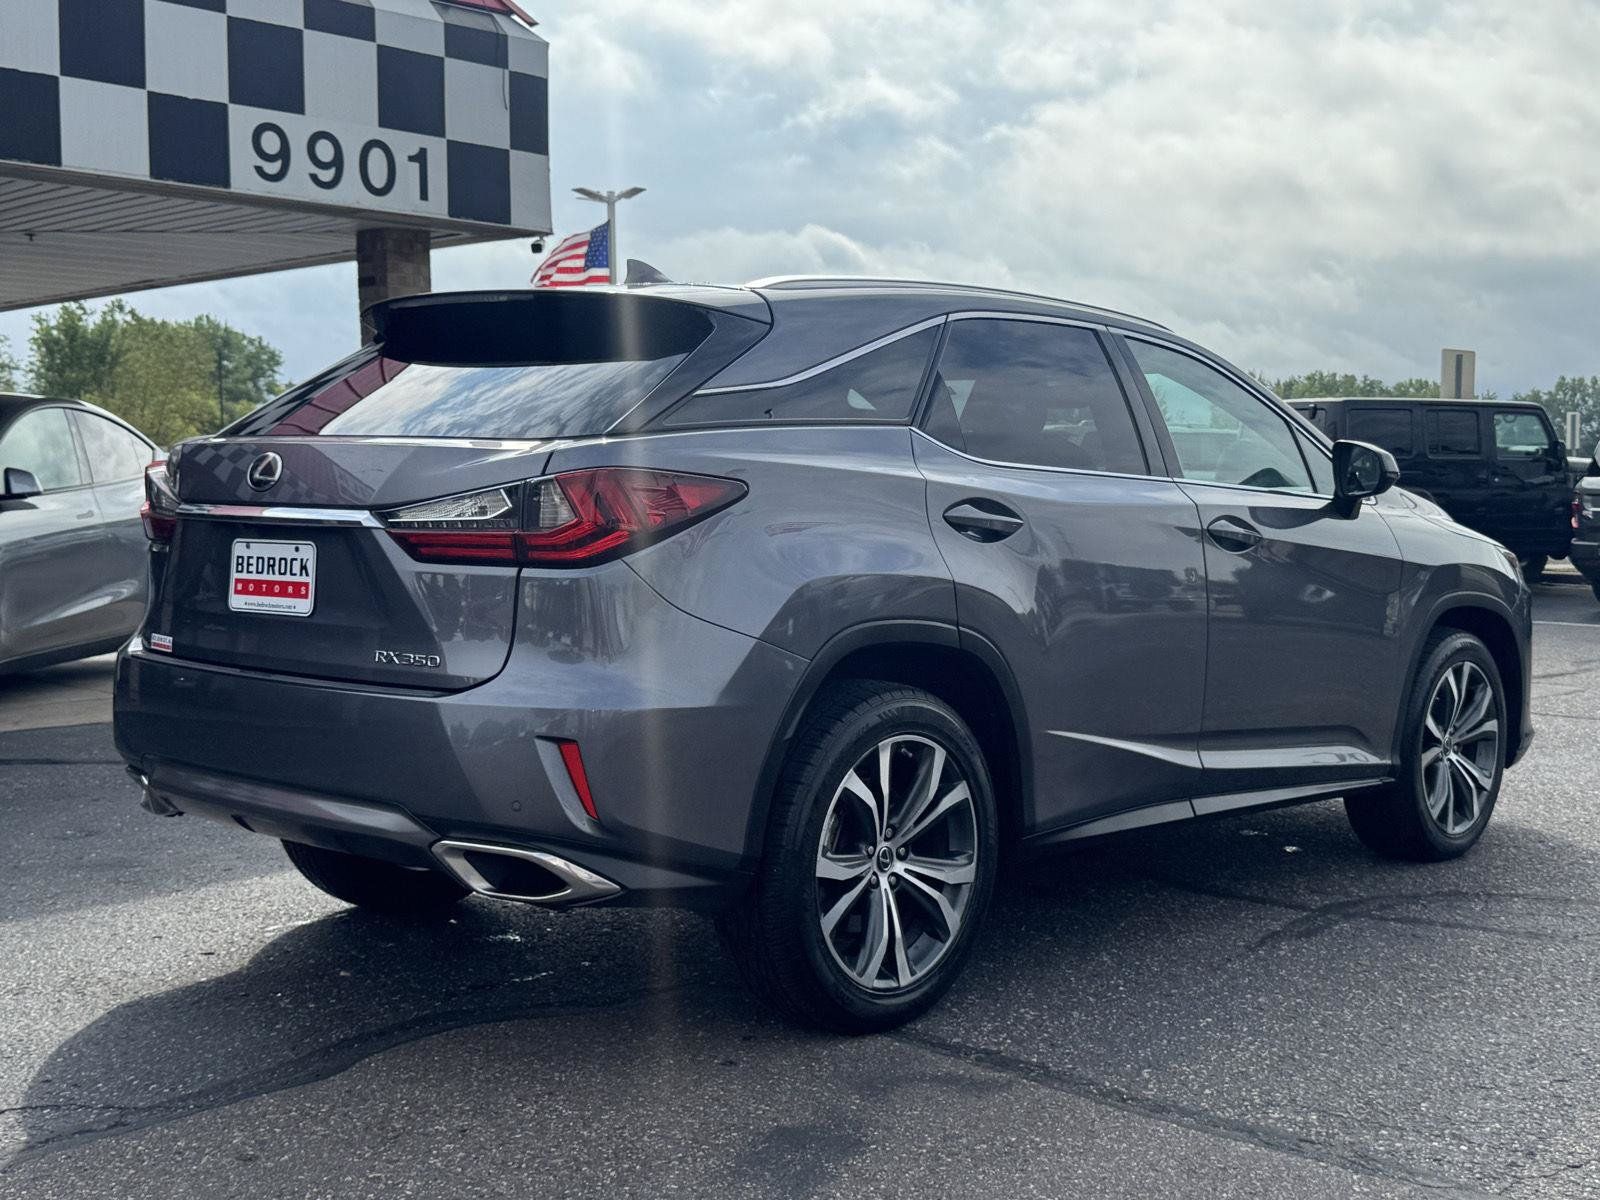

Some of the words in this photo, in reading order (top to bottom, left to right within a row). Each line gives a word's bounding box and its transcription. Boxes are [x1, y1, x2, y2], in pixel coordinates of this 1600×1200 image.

[251, 122, 429, 202] 9901
[235, 555, 310, 577] BEDROCK
[236, 583, 307, 595] MOTORS
[375, 650, 440, 667] RX350
